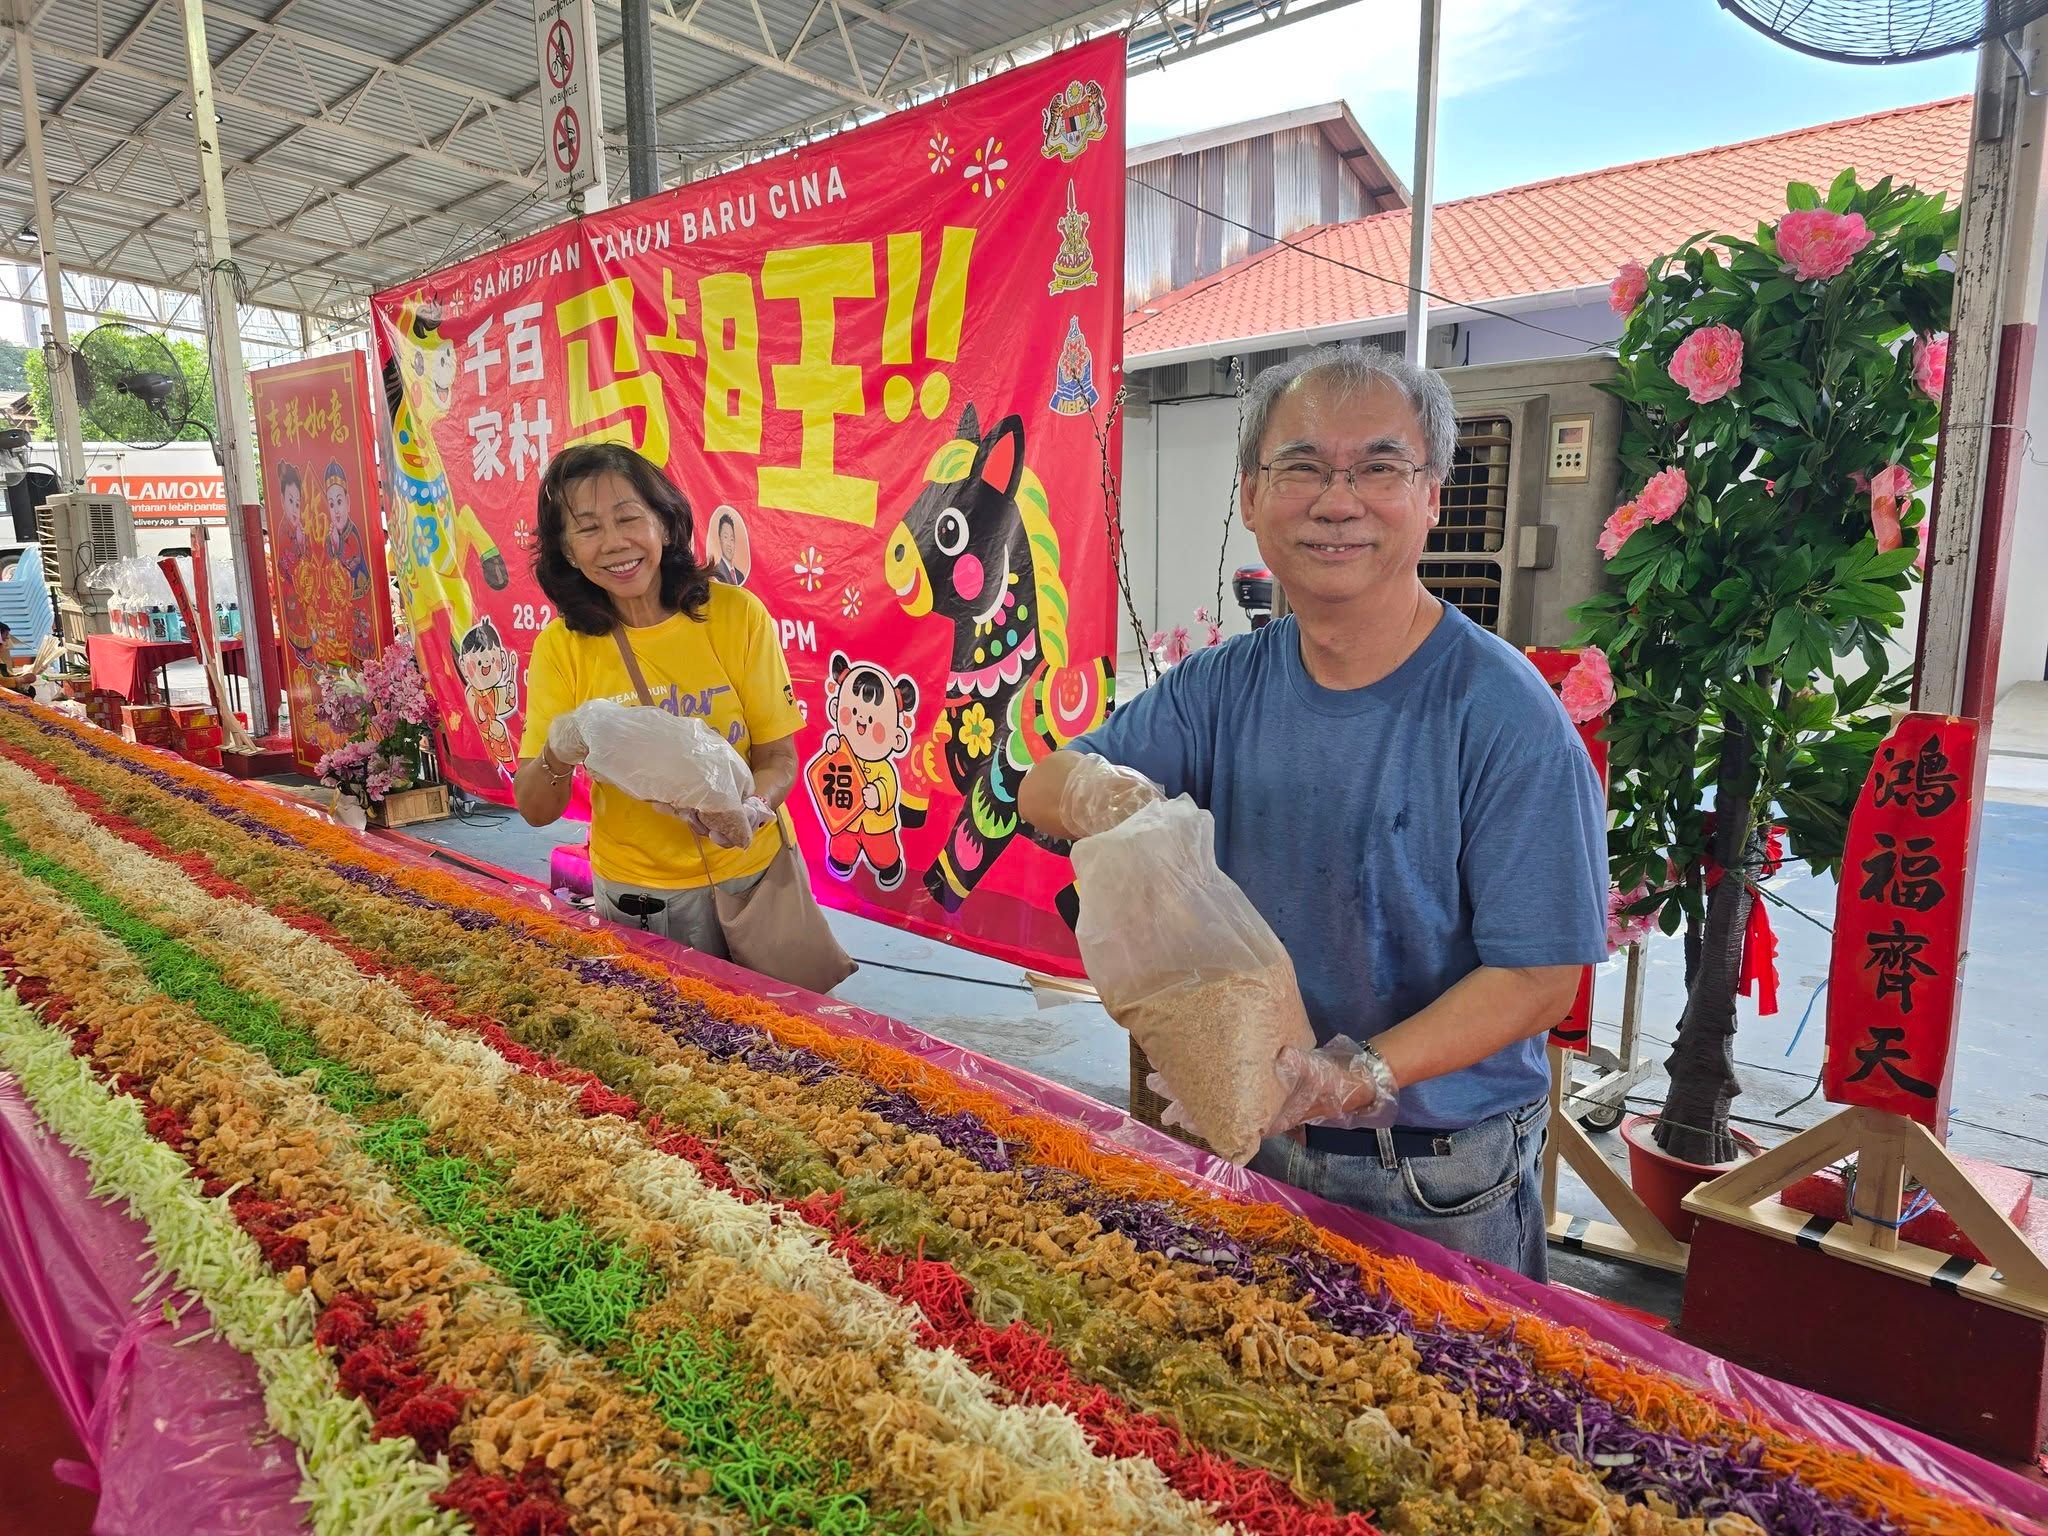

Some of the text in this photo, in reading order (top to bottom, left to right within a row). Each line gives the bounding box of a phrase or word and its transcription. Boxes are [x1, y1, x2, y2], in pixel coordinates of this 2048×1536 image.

[538, 12, 547, 24] NO
[549, 95, 557, 106] NO
[555, 180, 562, 190] NO
[473, 166, 847, 302] SAMBUTAN TAHUN BARU CINA
[463, 302, 544, 397] 千百
[266, 388, 349, 448] 吉祥如意
[466, 400, 552, 482] 家村
[160, 518, 175, 527] App
[168, 503, 193, 512] lebih
[193, 502, 227, 514] pantas
[822, 761, 854, 808] 福
